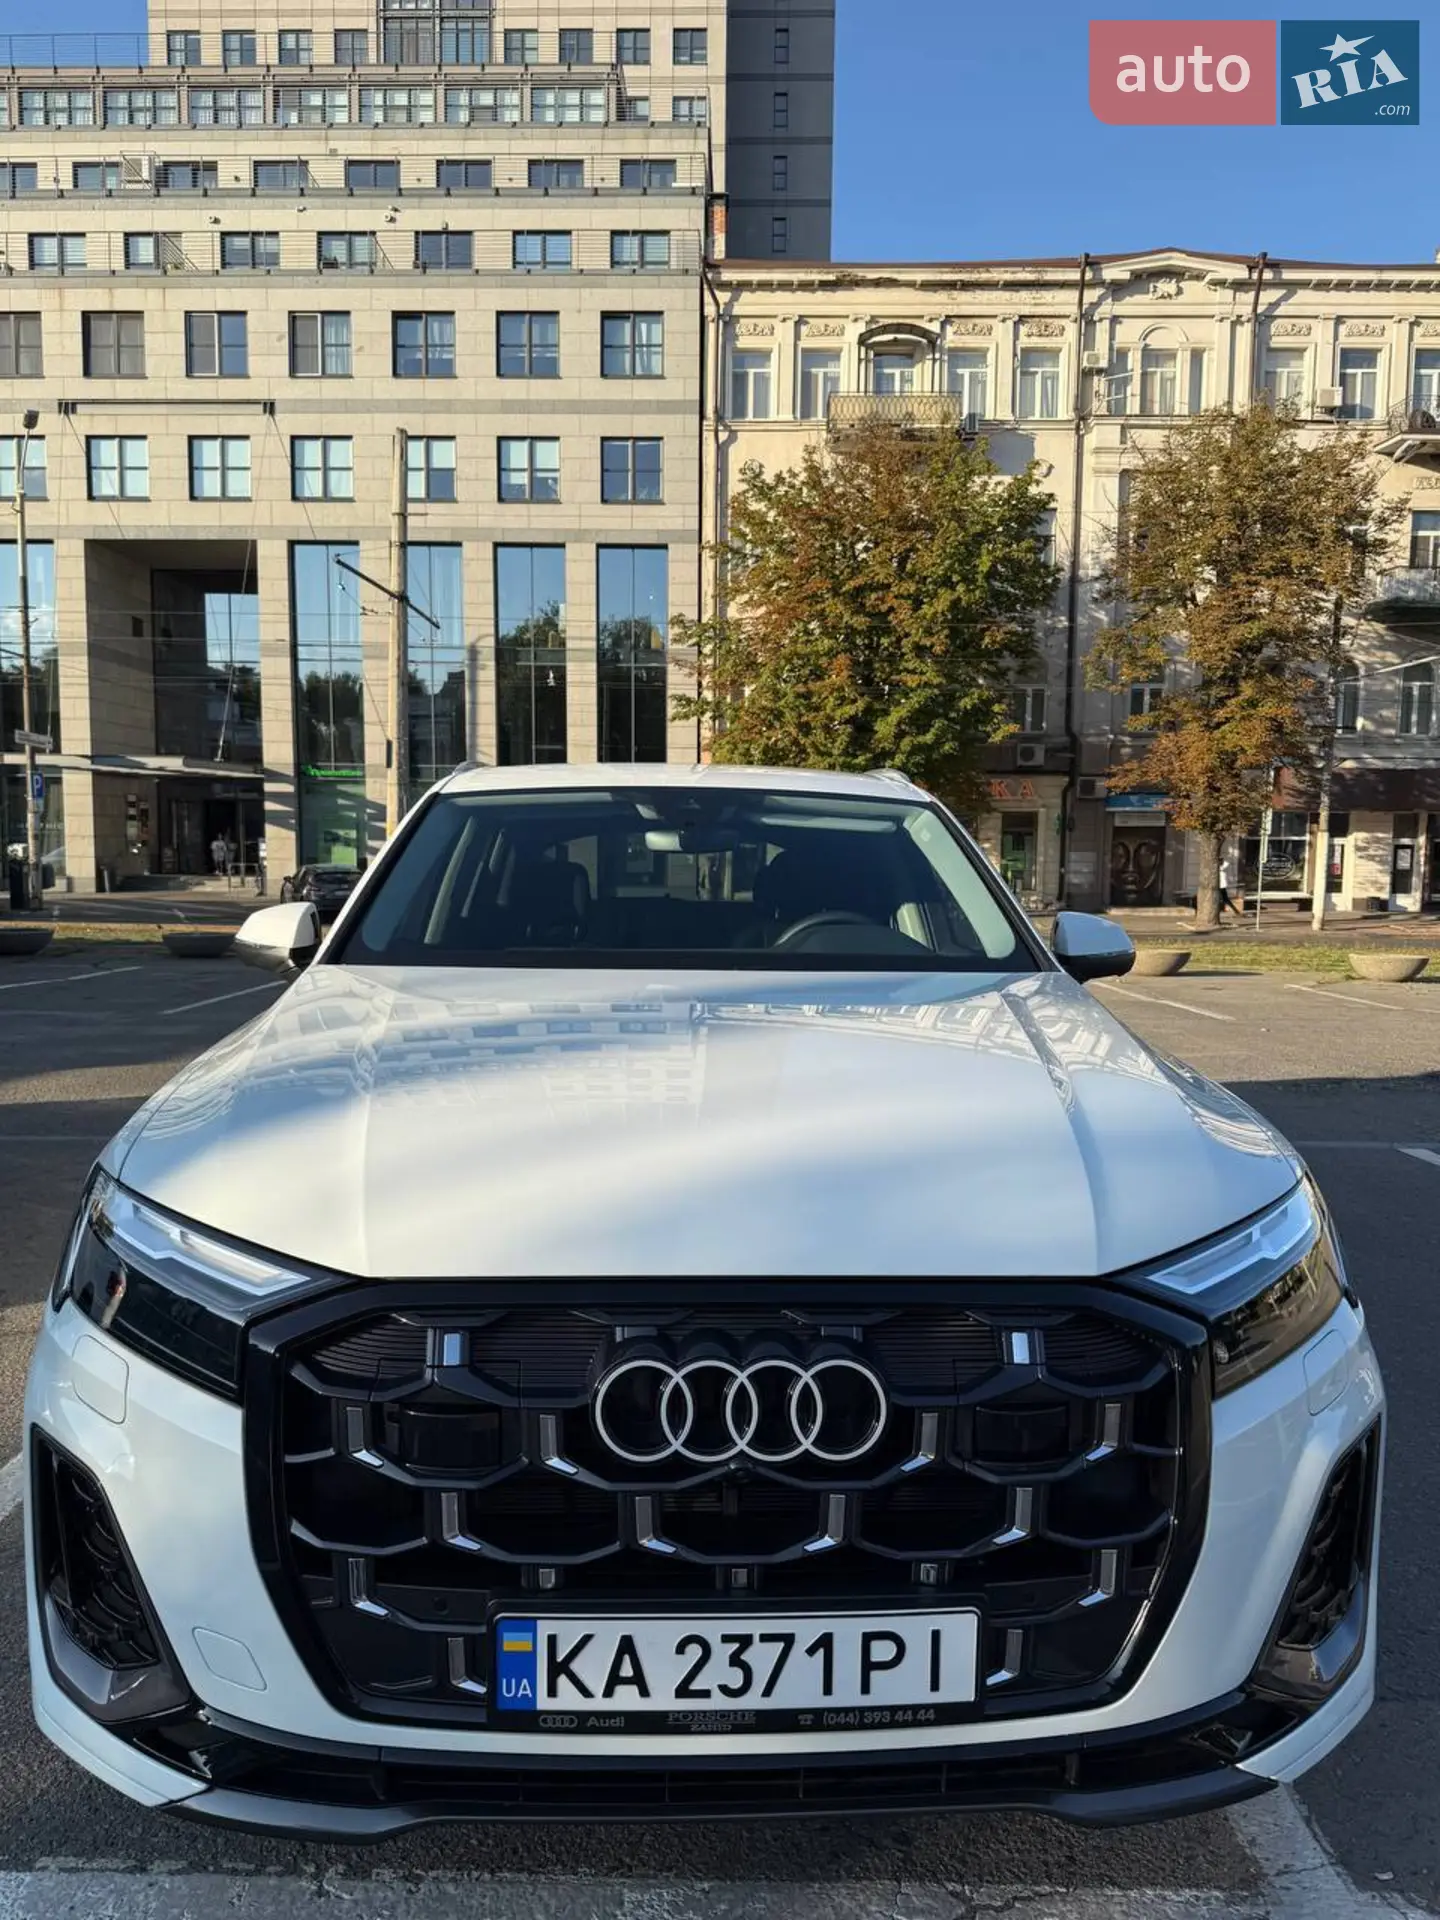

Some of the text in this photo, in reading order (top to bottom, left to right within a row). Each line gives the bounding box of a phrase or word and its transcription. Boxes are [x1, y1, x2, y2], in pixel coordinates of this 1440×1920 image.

[546, 1628, 941, 1699] KA 2371 PI
[502, 1678, 532, 1699] UA
[587, 1715, 625, 1728] Audi
[667, 1711, 756, 1722] PORSCHE
[823, 1708, 936, 1728] (044) 393 44 44
